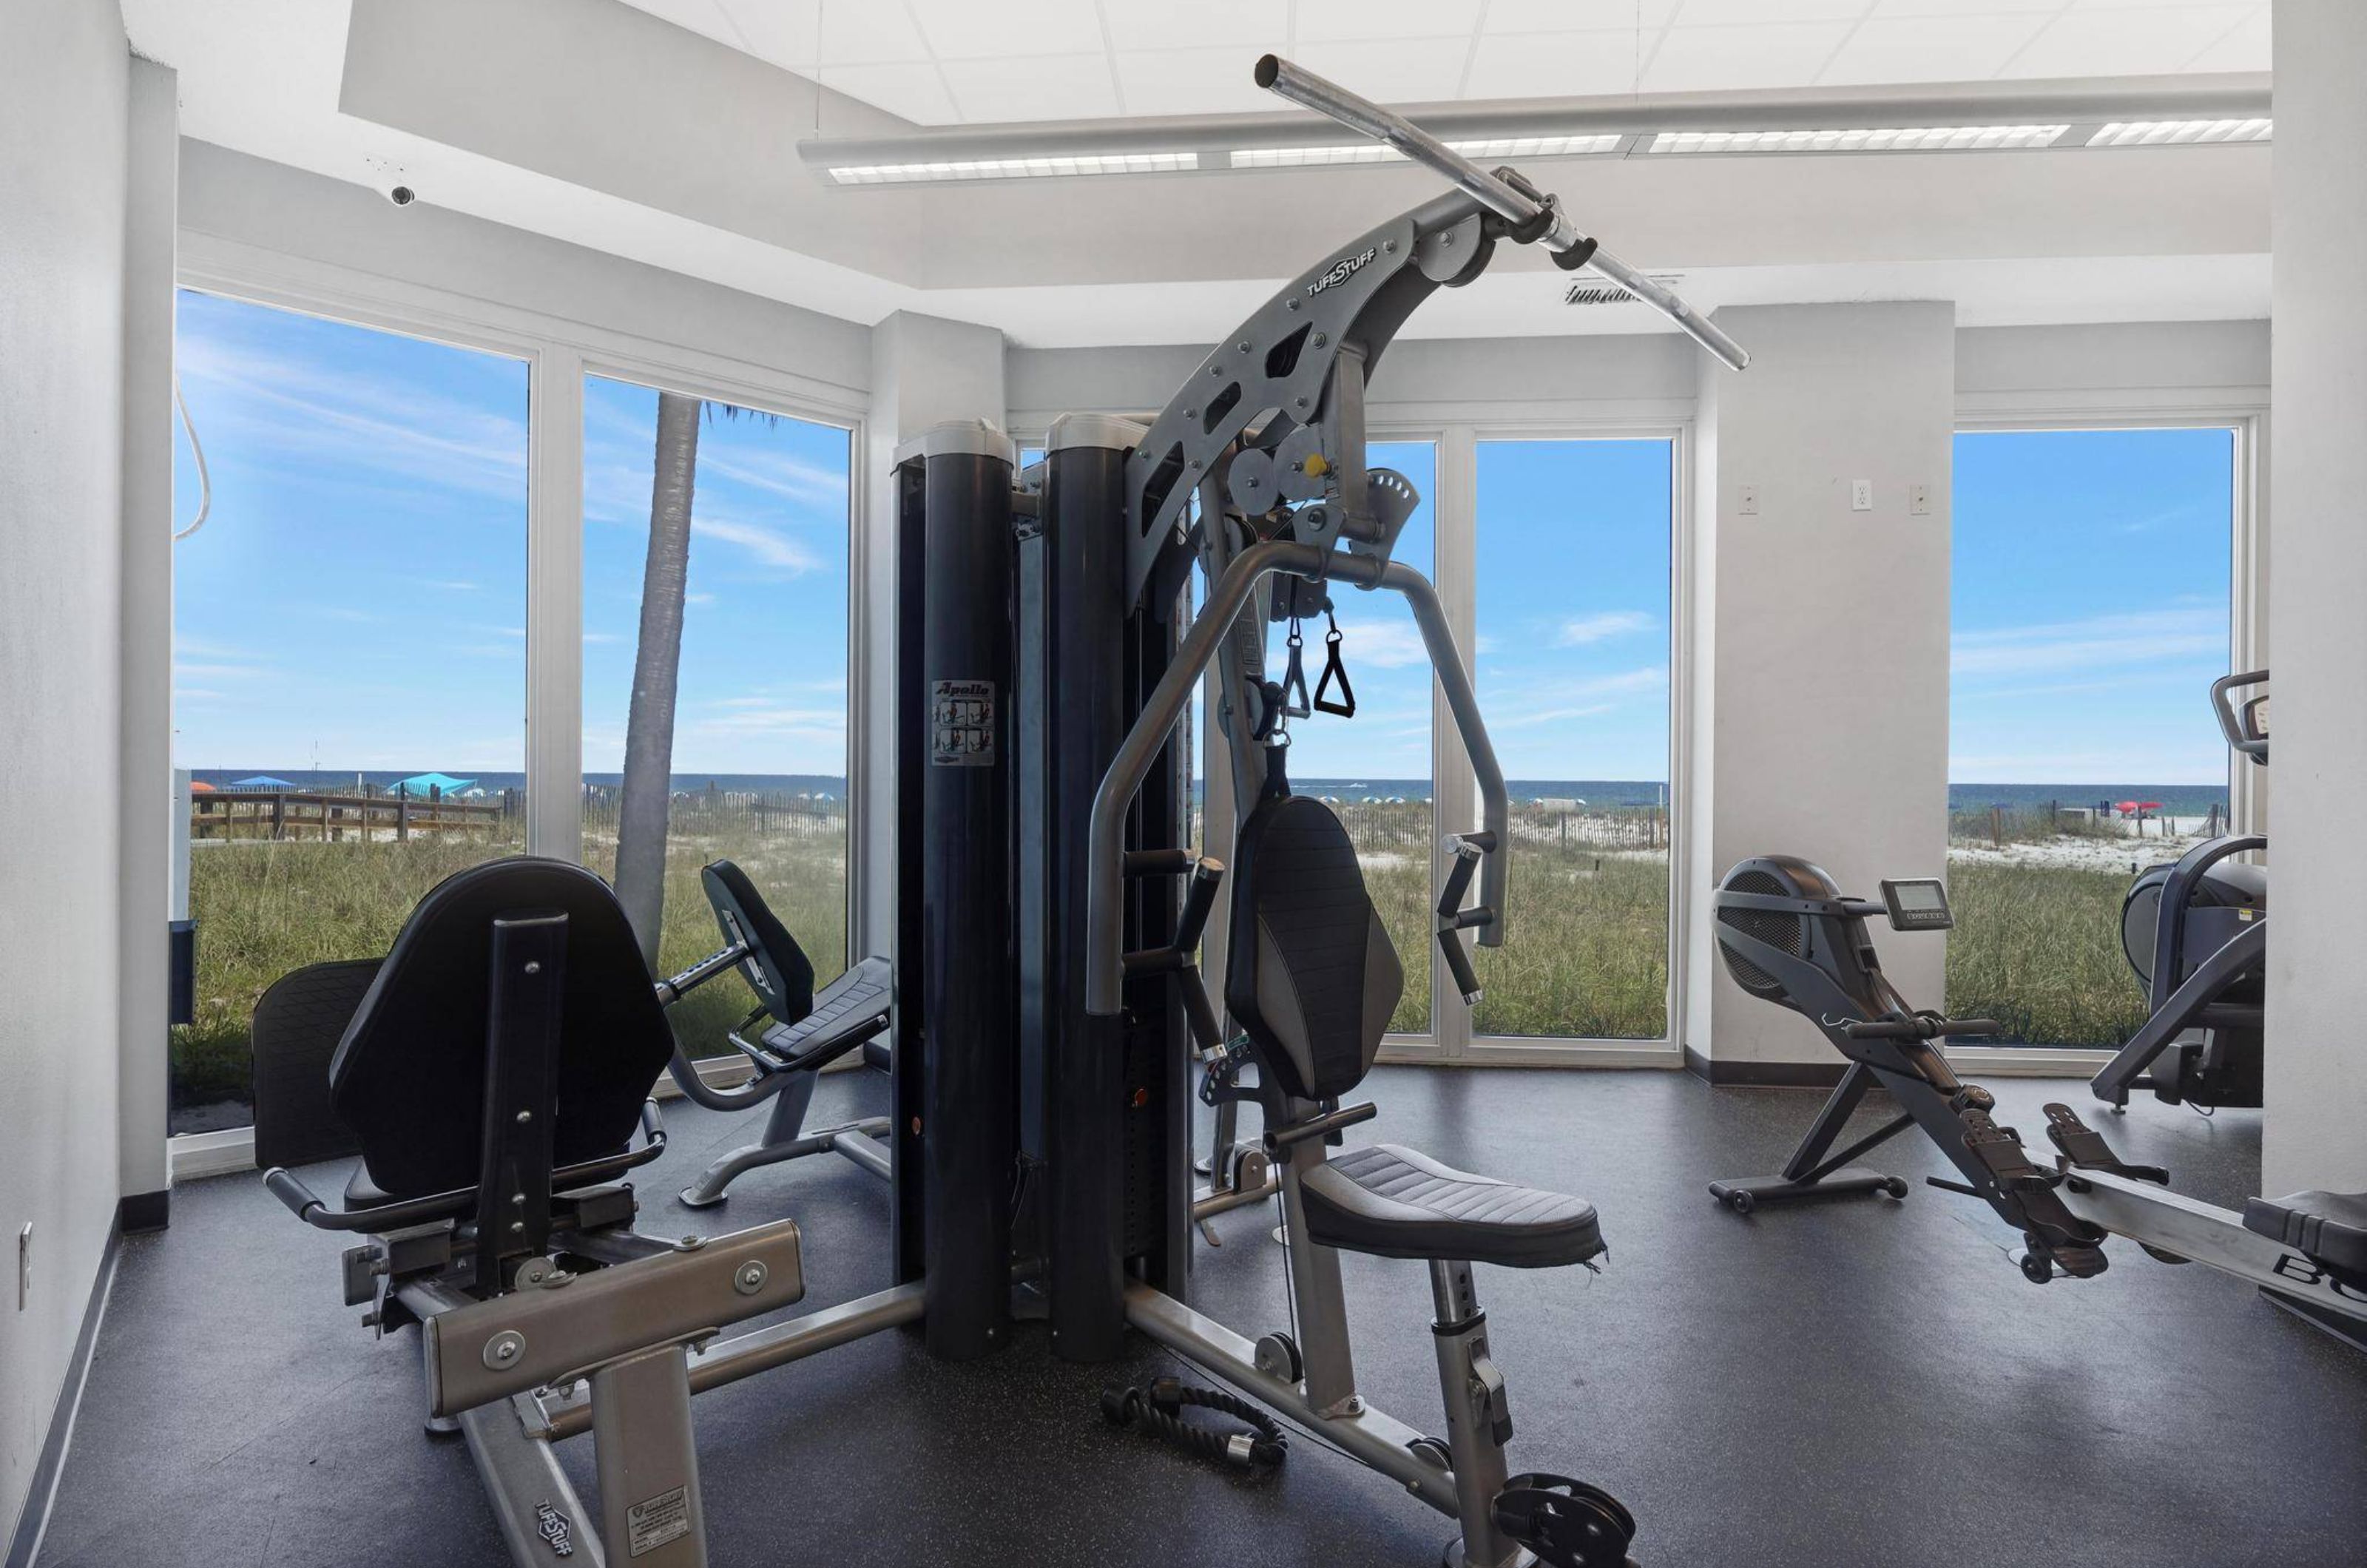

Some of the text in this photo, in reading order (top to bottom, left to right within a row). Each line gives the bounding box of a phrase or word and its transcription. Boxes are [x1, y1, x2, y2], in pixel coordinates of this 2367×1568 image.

[1306, 247, 1377, 297] TUFFSTUFF
[936, 681, 990, 697] Apollo
[535, 1498, 573, 1556] TUFFSTUFF
